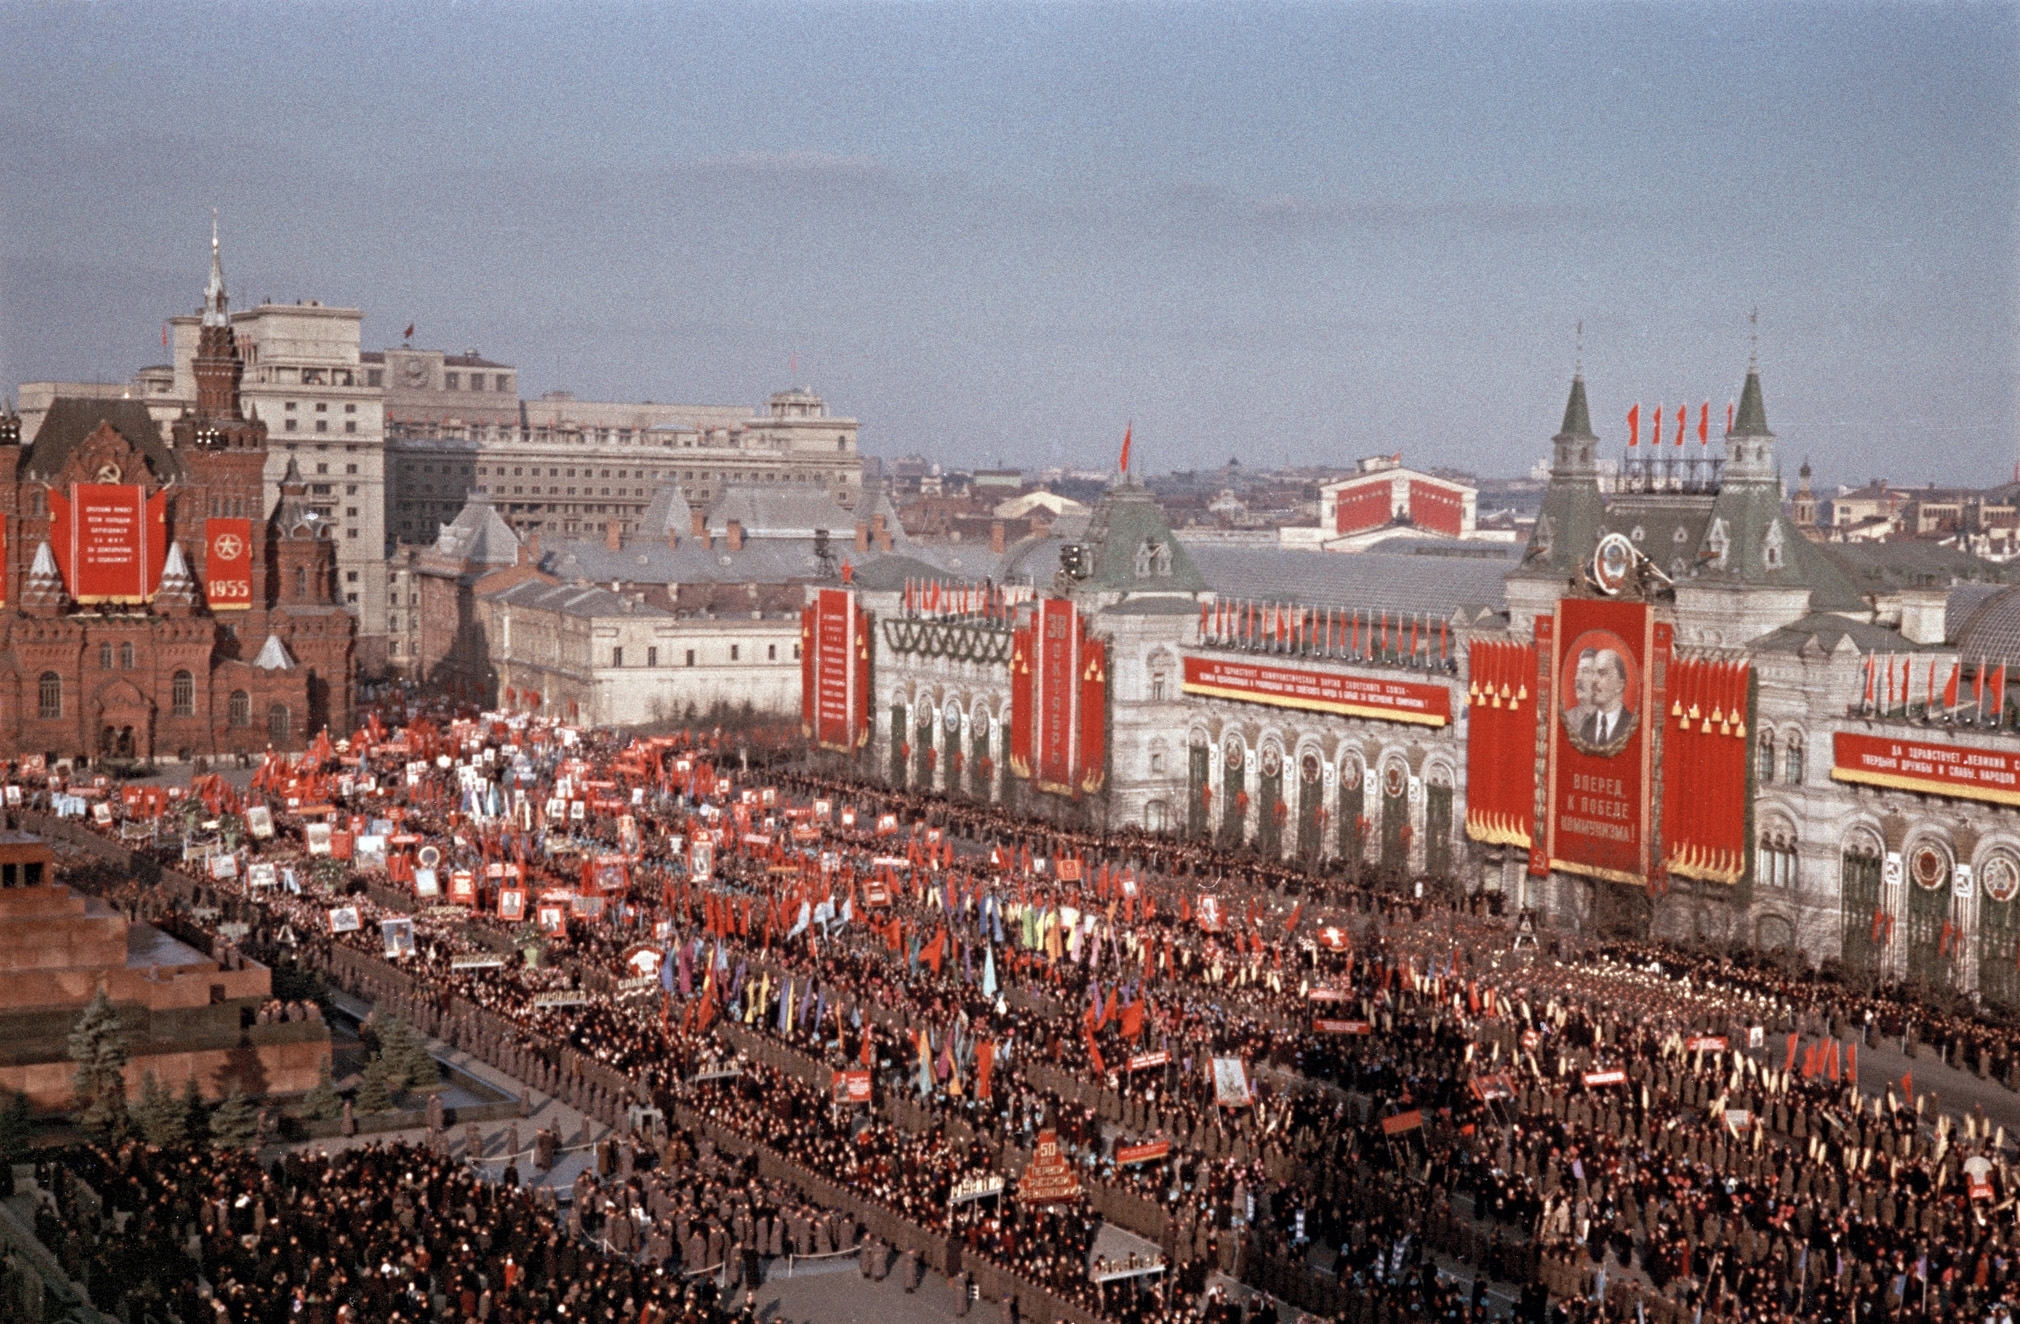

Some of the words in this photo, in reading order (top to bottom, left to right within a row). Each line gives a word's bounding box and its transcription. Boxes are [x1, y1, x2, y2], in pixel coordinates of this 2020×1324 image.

[209, 580, 249, 598] 1955
[1047, 613, 1067, 640] 38
[1891, 744, 1902, 757] ДА
[1908, 747, 1960, 763] ЗДРАВСТВУЕТ
[1967, 754, 2006, 769] ВЕЛИКИЙ
[1901, 759, 1933, 774] ДРУЖБЫ
[1567, 794, 1575, 811] К
[1581, 796, 1629, 819] ПОБЕДЕ
[1560, 815, 1635, 844] КОММУНИЗМА!
[1040, 1142, 1056, 1157] 50
